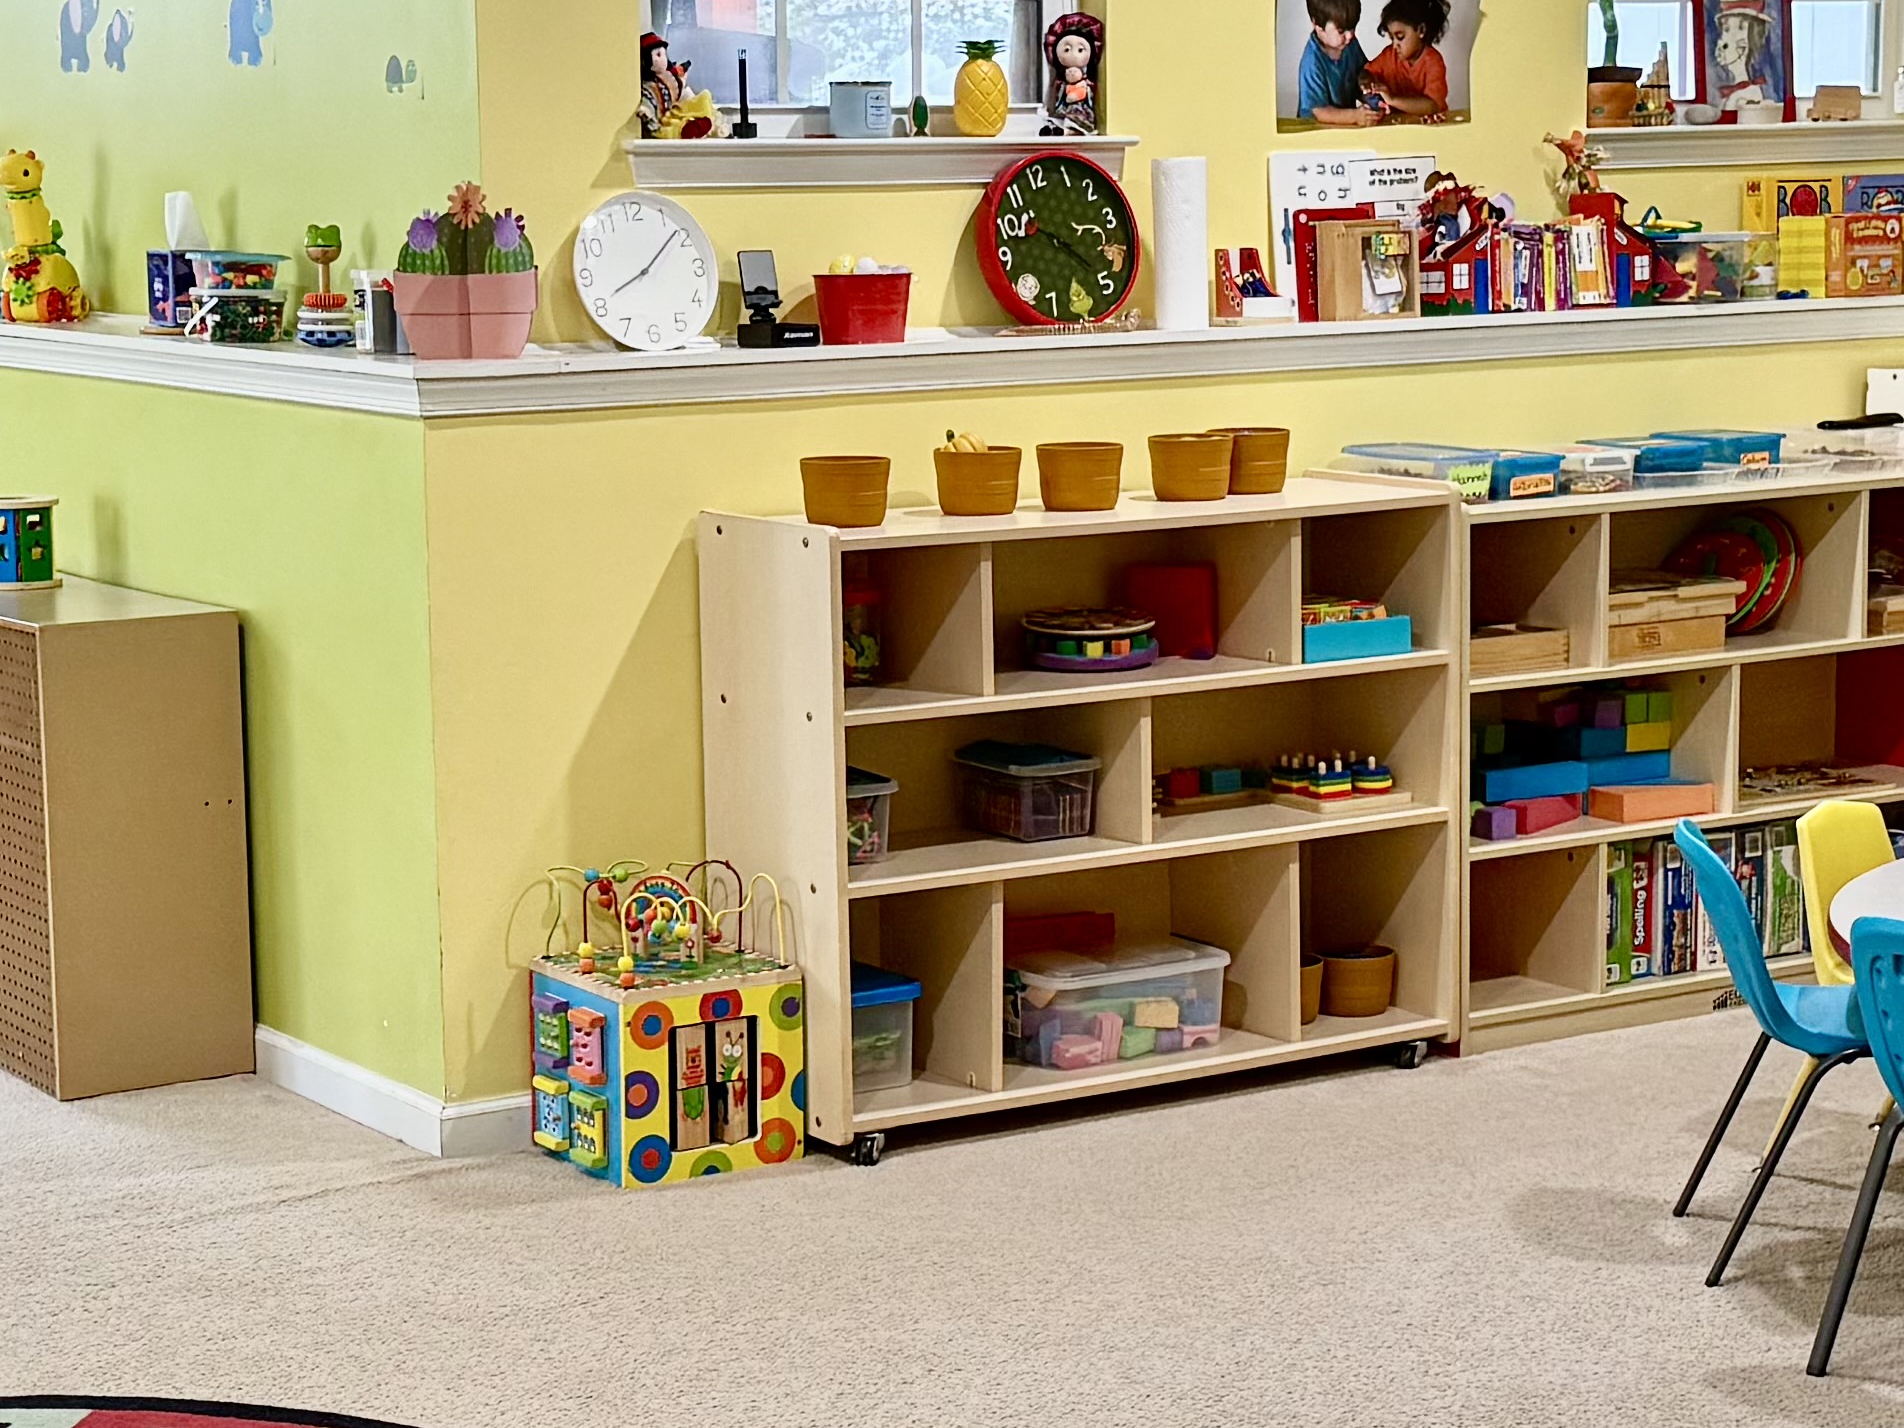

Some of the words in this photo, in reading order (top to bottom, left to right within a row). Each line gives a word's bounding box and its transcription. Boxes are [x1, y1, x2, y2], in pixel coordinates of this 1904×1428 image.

[1026, 164, 1047, 190] 12
[1061, 165, 1071, 188] 1
[1007, 184, 1023, 208] 11
[1082, 179, 1097, 202] 2
[622, 201, 643, 222] 12
[657, 207, 666, 226] 1
[1102, 207, 1117, 229] 3
[600, 213, 615, 234] 11
[997, 213, 1018, 240] 10
[678, 228, 693, 247] 2
[581, 238, 603, 259] 10
[998, 246, 1012, 271] 9
[579, 268, 593, 287] 9
[692, 258, 705, 277] 3
[1097, 271, 1114, 295] 5
[594, 298, 608, 317] 8
[692, 289, 702, 308] 4
[1045, 291, 1058, 317] 7
[619, 317, 632, 338] 7
[674, 312, 687, 332] 5
[648, 324, 661, 343] 6
[1633, 889, 1648, 946] Spelling
